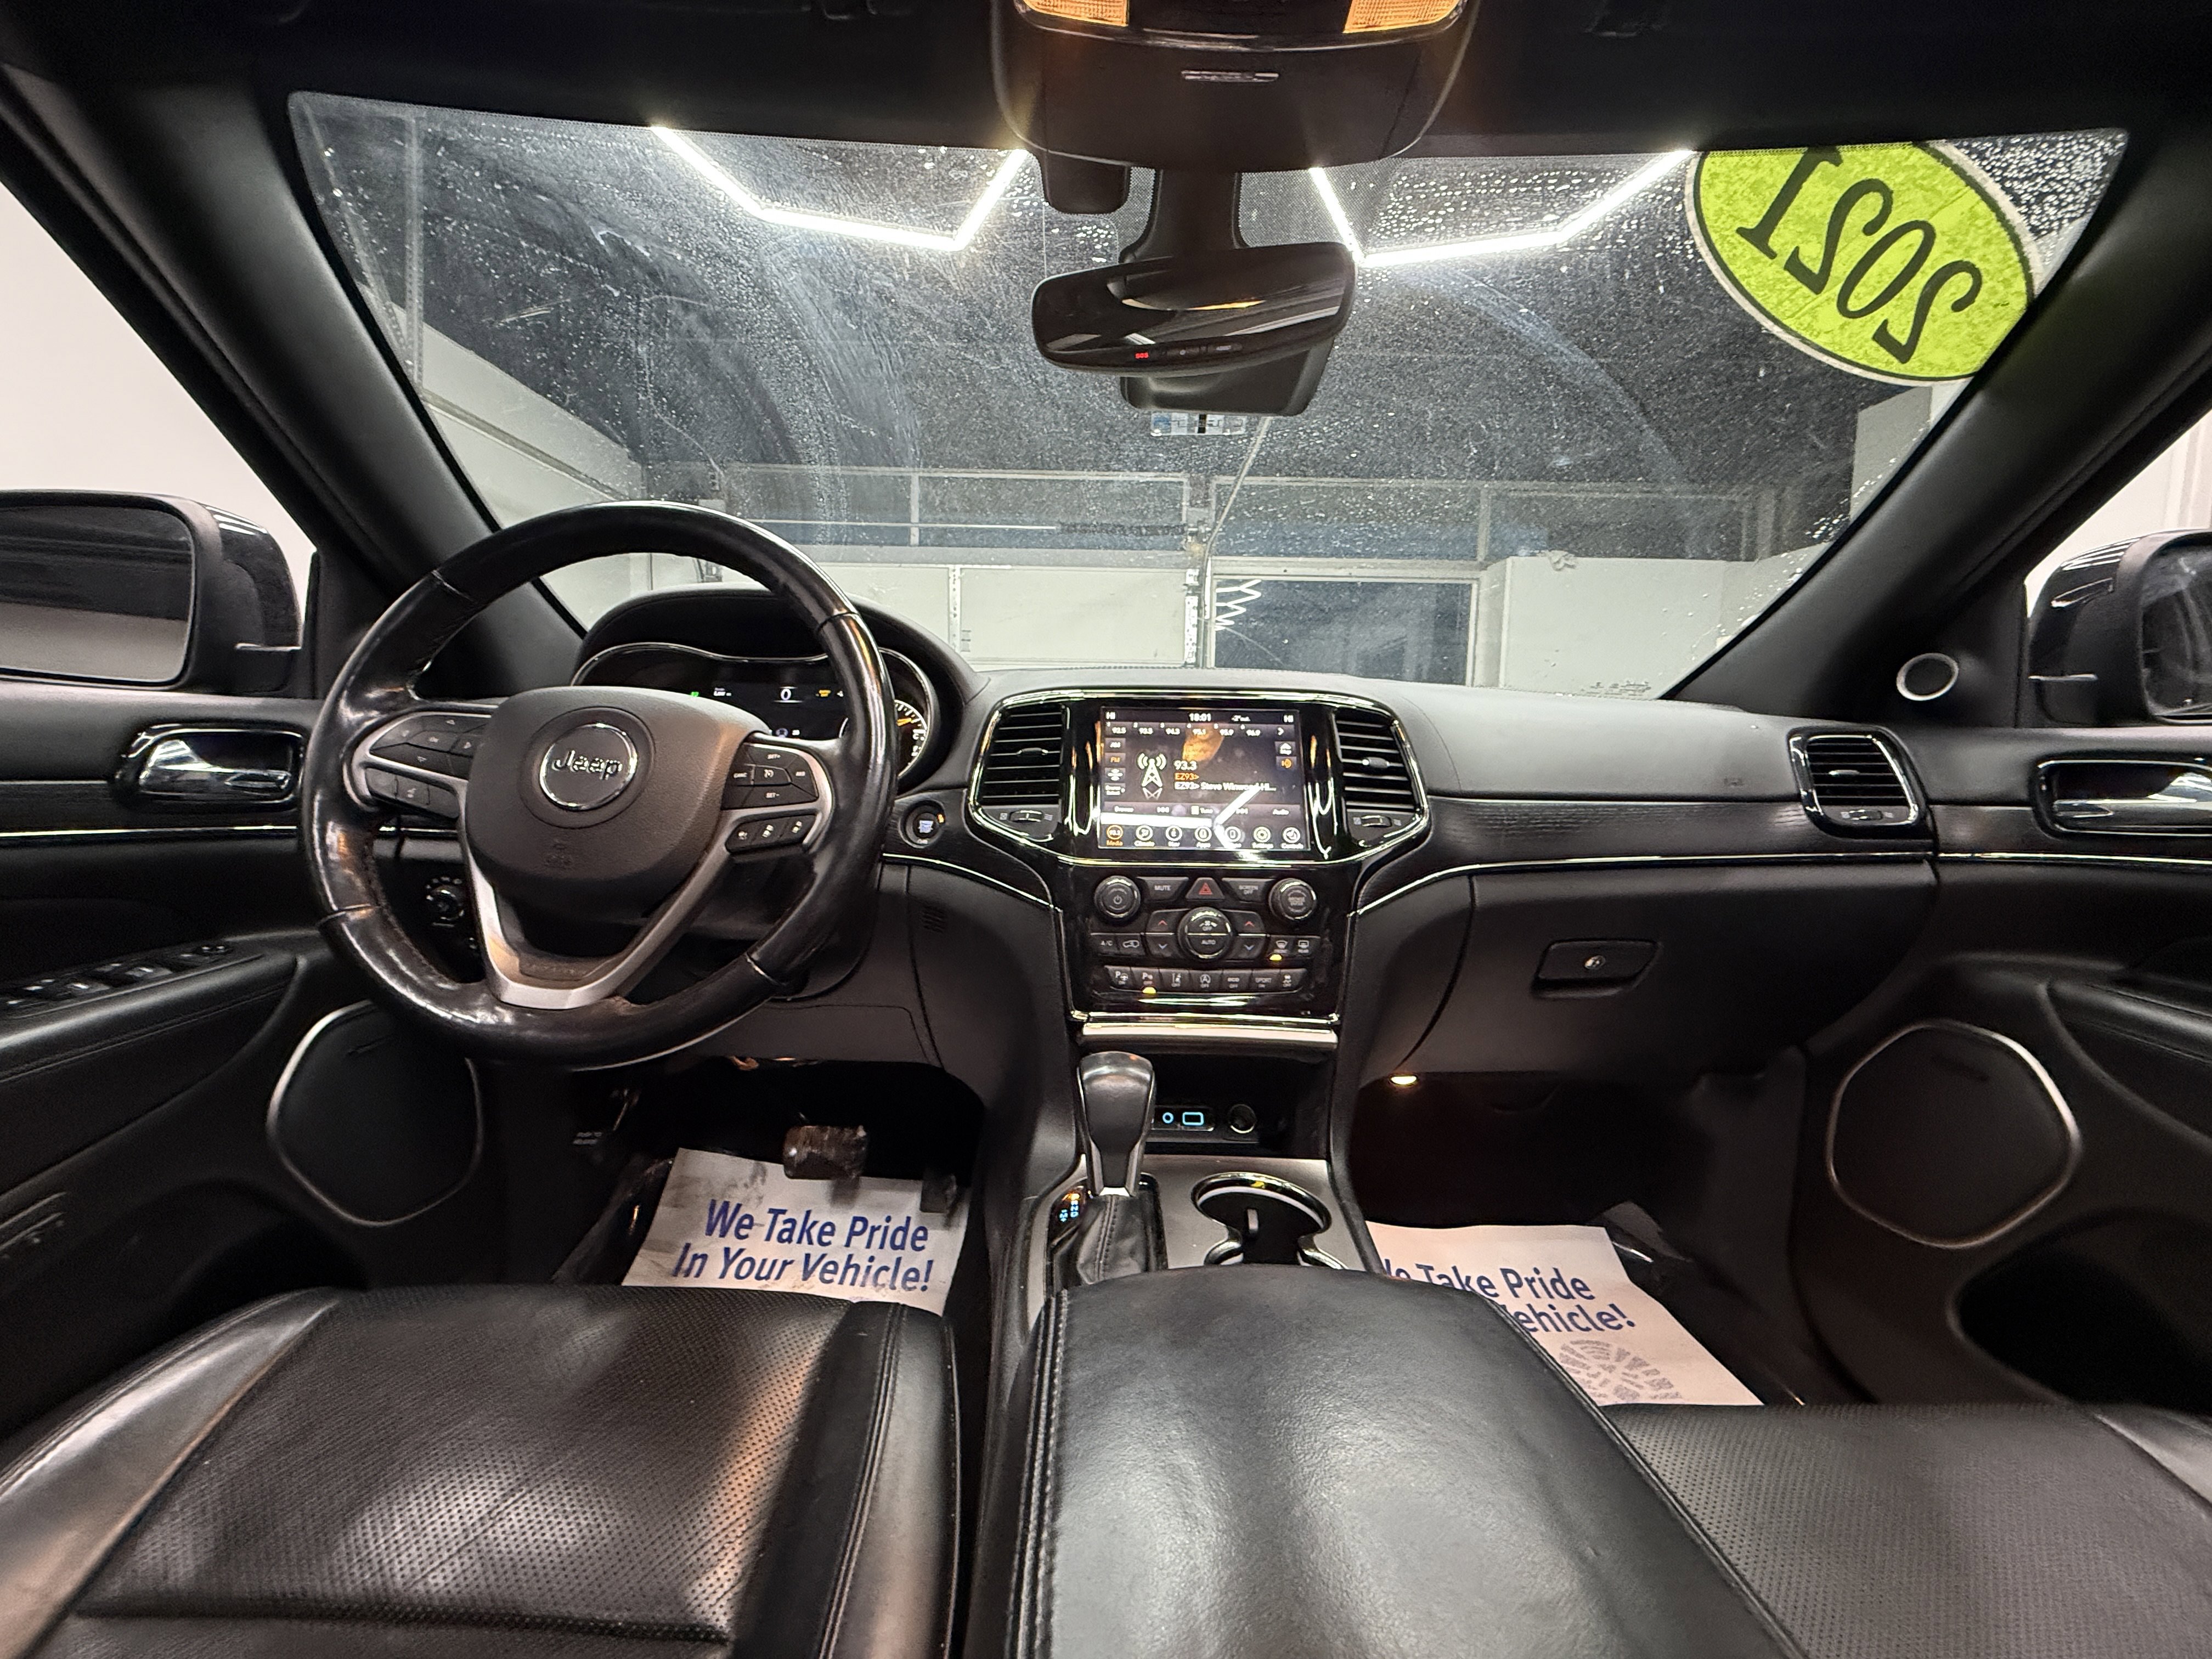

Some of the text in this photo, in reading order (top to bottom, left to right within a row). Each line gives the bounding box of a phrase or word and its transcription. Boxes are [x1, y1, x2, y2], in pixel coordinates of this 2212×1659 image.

[1189, 713, 1211, 721] 18:01
[552, 750, 623, 780] Jeep
[1174, 760, 1197, 770] 93.3
[705, 1199, 928, 1252] We Take Pride
[672, 1243, 934, 1292] In Your Vehicle!
[1415, 1263, 1500, 1297] Take
[1499, 1267, 1595, 1300] Pride
[1500, 1303, 1635, 1333] ehicle!
